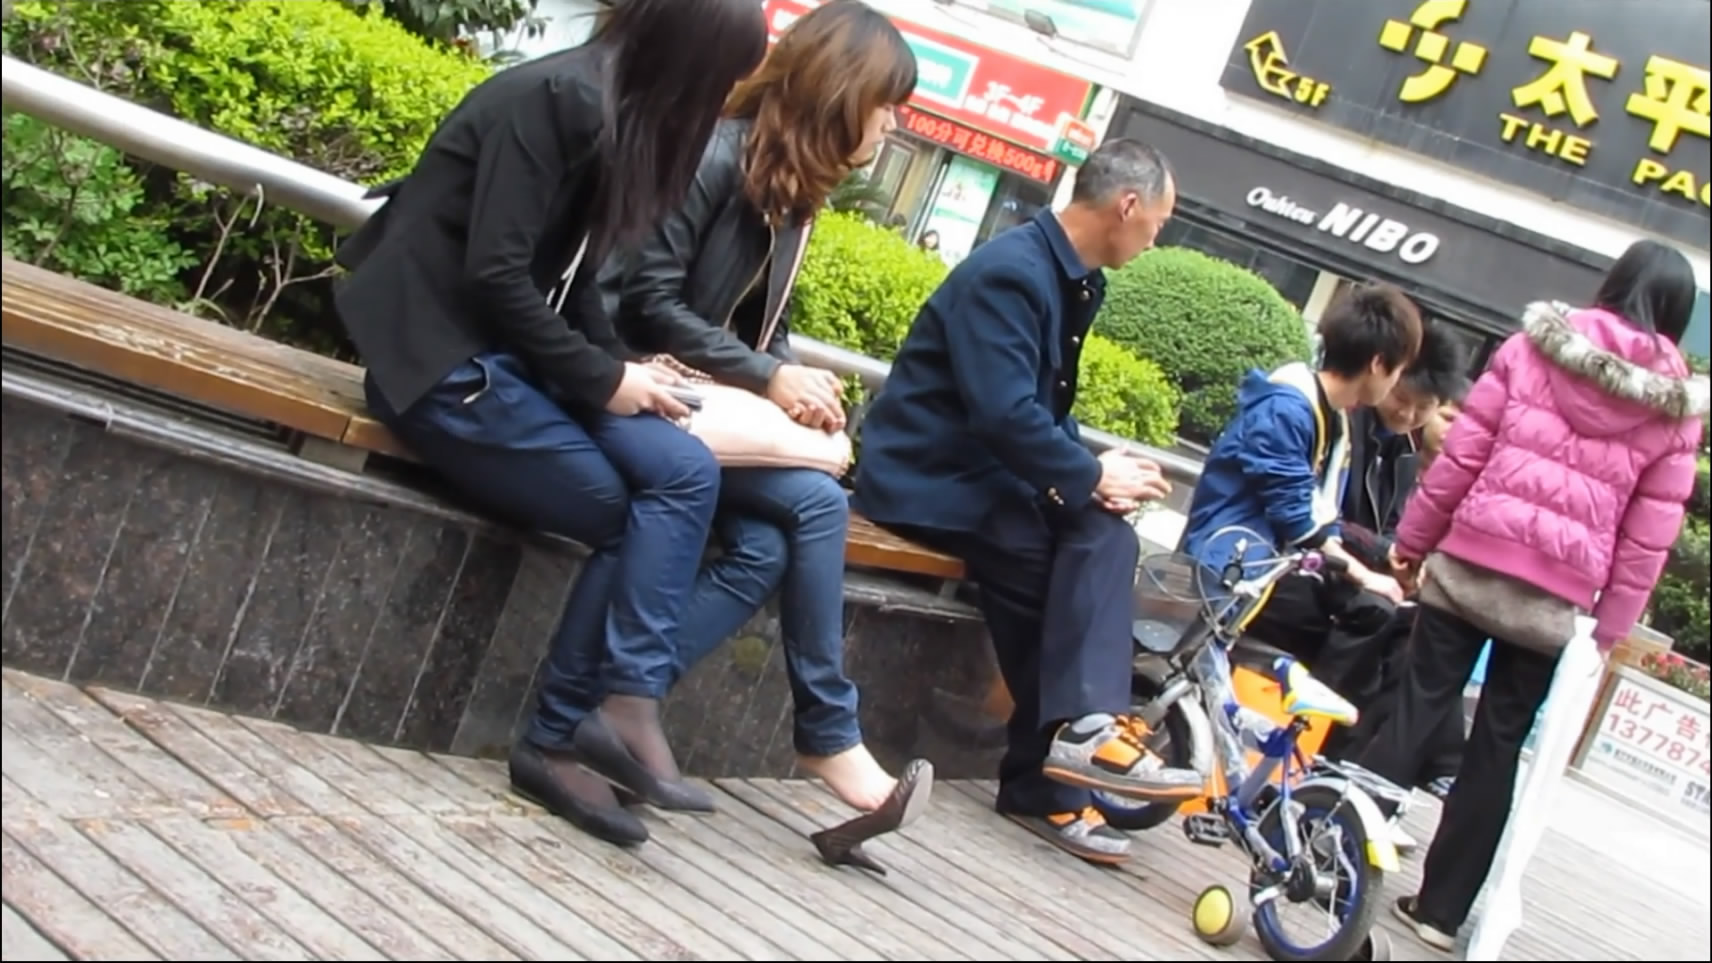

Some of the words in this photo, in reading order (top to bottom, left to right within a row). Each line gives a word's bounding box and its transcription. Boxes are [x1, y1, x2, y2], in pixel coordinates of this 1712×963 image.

[1294, 76, 1330, 108] 5F
[1500, 112, 1592, 166] THE
[1317, 202, 1440, 264] NIBO
